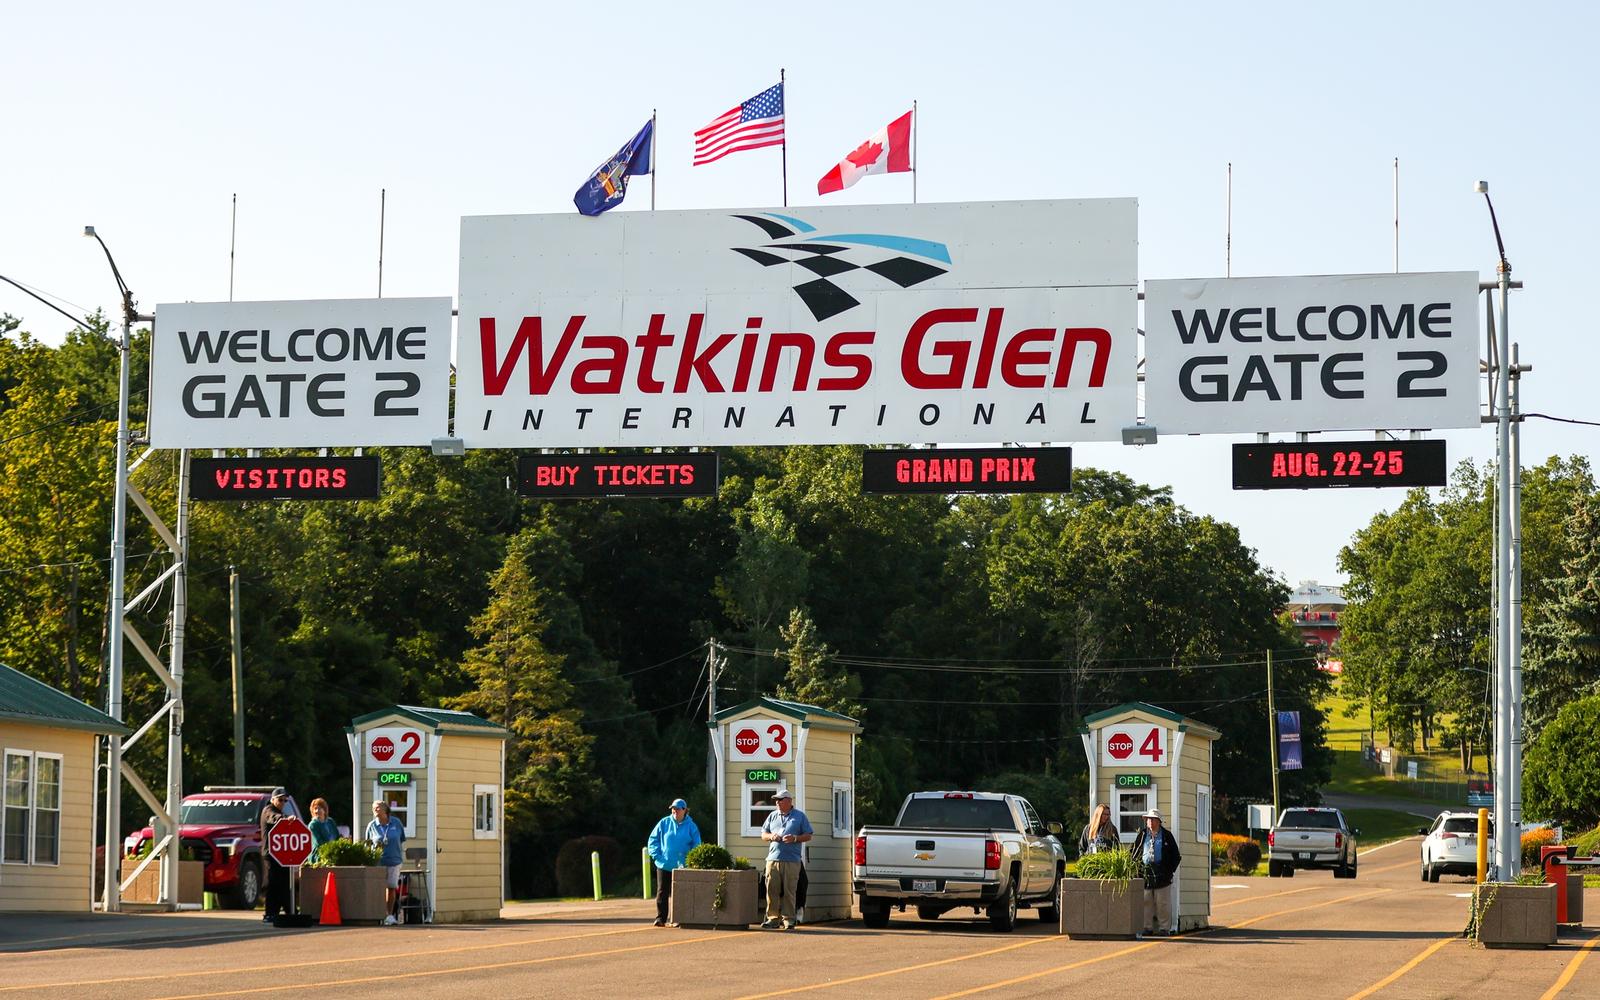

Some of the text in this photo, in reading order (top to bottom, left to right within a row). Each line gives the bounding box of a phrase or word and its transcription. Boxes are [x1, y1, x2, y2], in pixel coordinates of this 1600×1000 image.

[1171, 302, 1452, 343] WELCOME
[178, 326, 427, 364] WELCOME
[479, 308, 1112, 395] Watkins Glen
[1178, 350, 1448, 403] GATE 2
[182, 371, 421, 419] GATE 2
[483, 402, 1097, 431] INTERNATIONAL
[536, 464, 694, 487] BUY TICKETS
[896, 457, 1036, 483] GRAND PRIX
[1271, 450, 1403, 478] AUG. 22-25
[215, 468, 347, 490] VISITORS
[372, 731, 421, 765] STOP 2
[736, 724, 788, 759] STOP 3
[1109, 728, 1163, 762] STOP 4
[380, 773, 408, 784] OPEN
[748, 771, 777, 781] OPEN
[1118, 776, 1148, 786] OPEN
[271, 833, 311, 852] STOP
